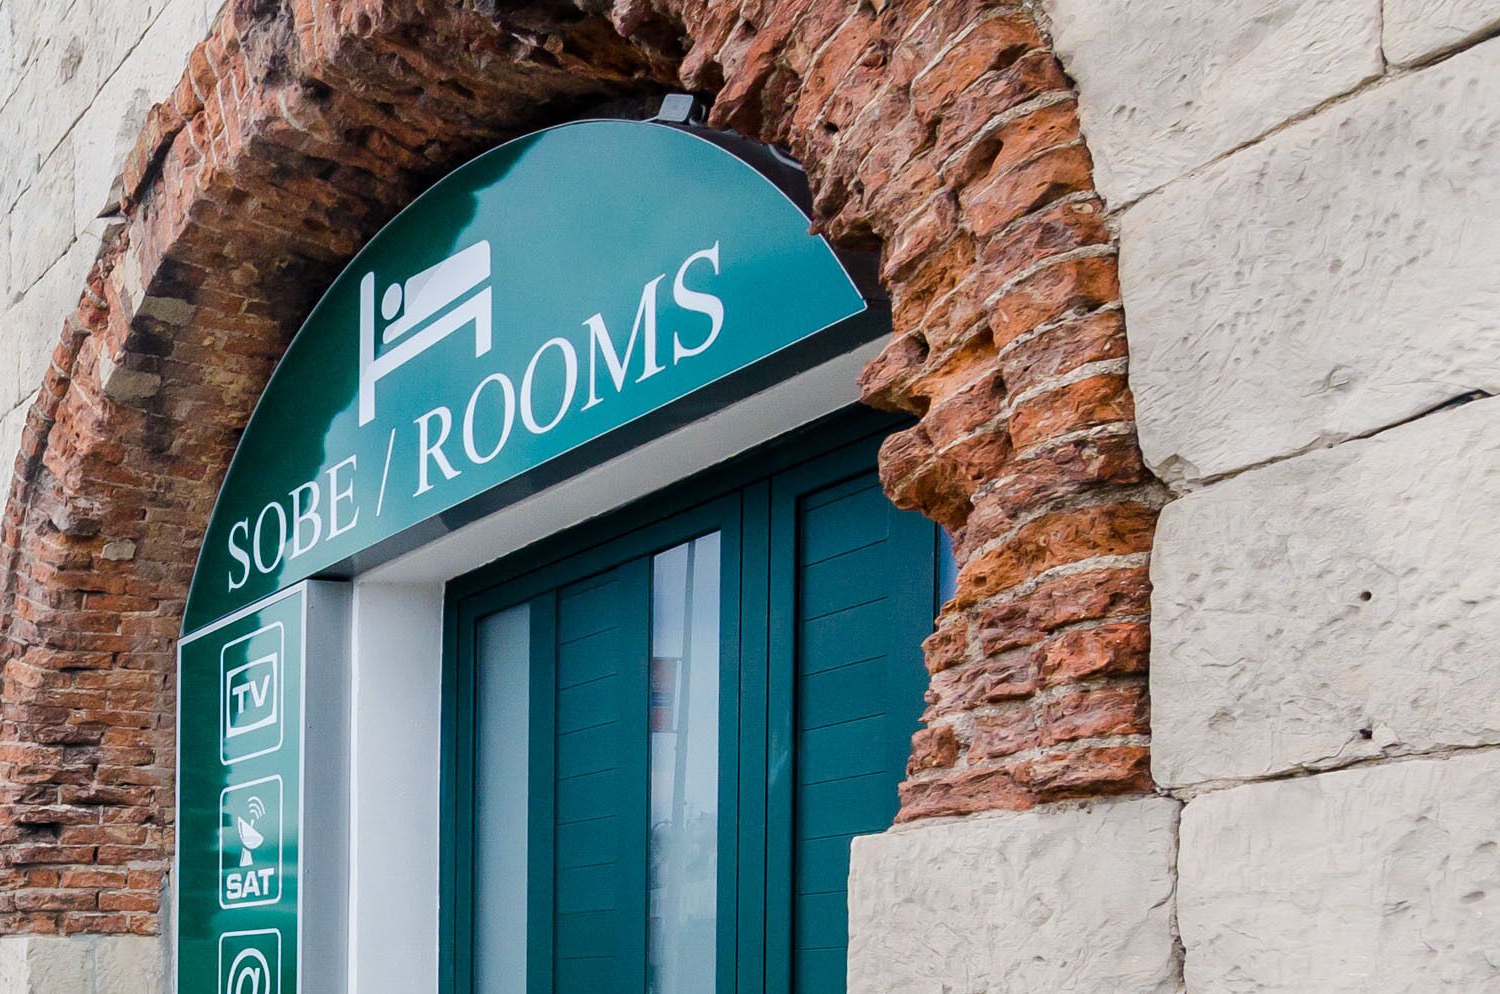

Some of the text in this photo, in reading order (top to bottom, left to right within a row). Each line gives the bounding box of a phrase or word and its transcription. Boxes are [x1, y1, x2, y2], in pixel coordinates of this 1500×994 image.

[227, 239, 725, 593] SOBE / ROOMS
[232, 674, 270, 714] TV
[226, 867, 275, 900] SAT
